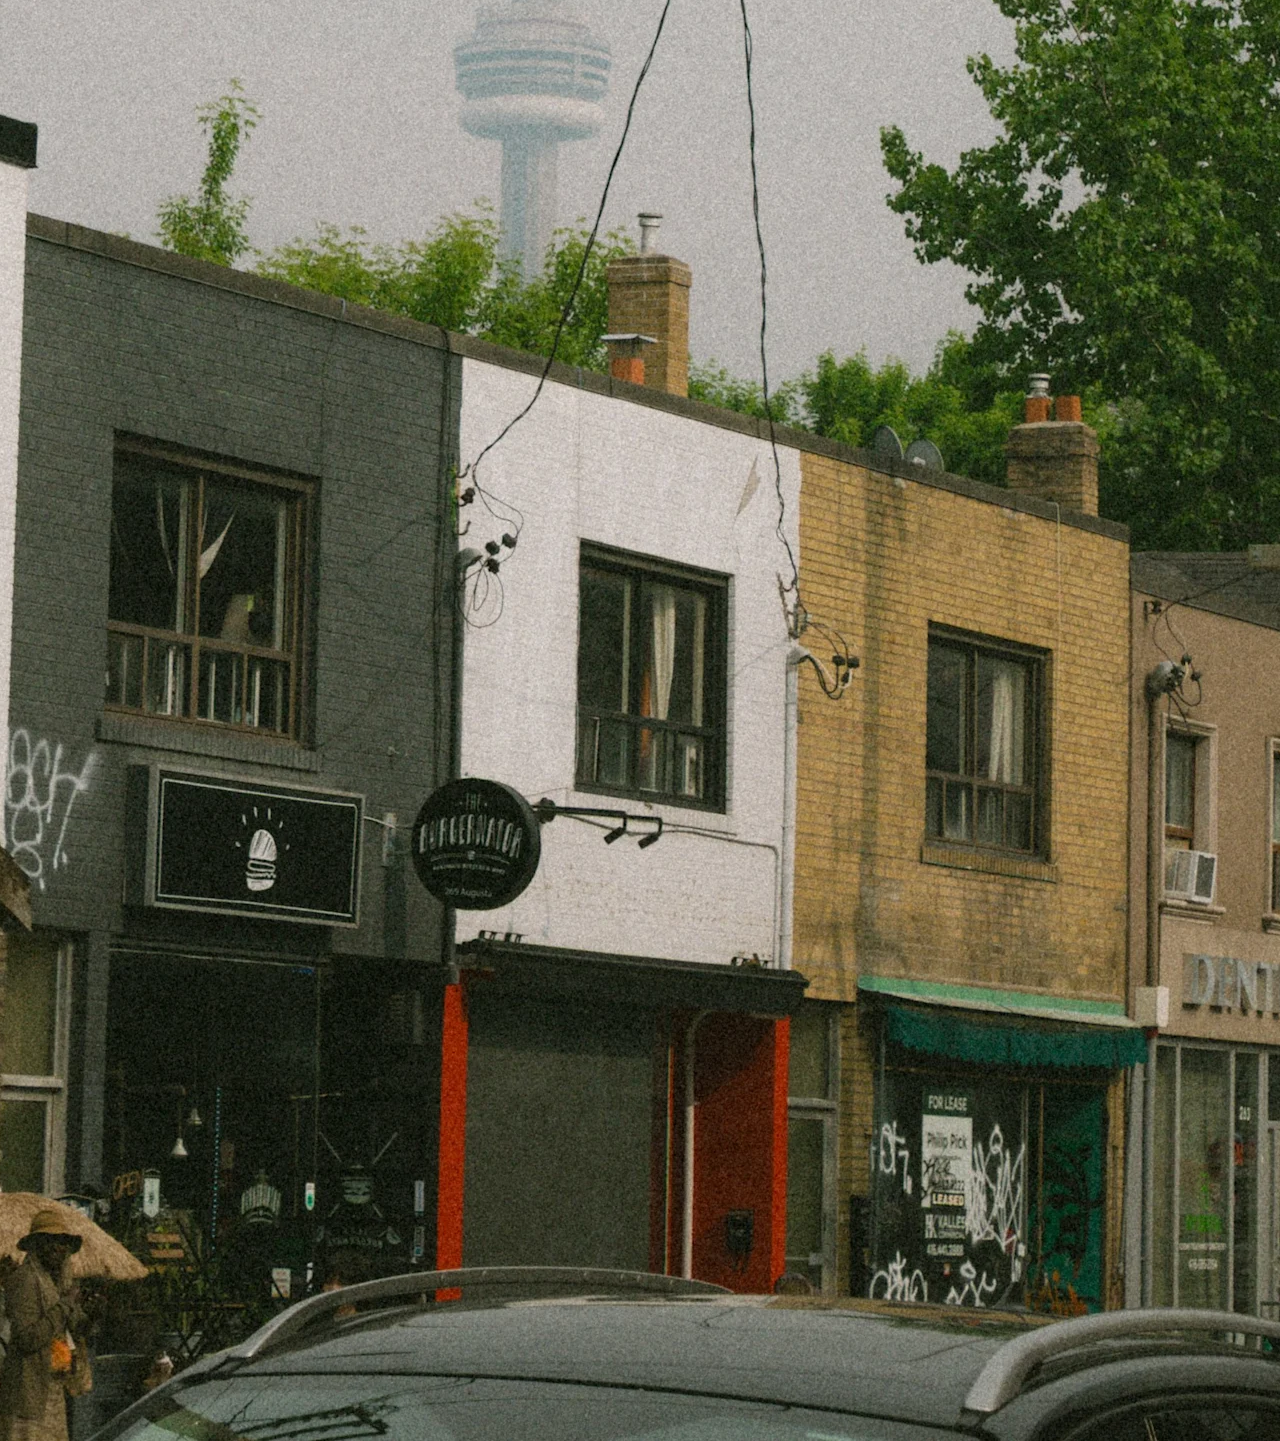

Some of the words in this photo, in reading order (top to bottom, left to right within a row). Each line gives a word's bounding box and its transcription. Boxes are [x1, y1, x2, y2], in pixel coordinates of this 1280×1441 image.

[419, 813, 523, 858] BURGERNATOR
[928, 1094, 943, 1110] FOR
[945, 1095, 968, 1112] LEASE
[932, 1192, 965, 1207] LEASED
